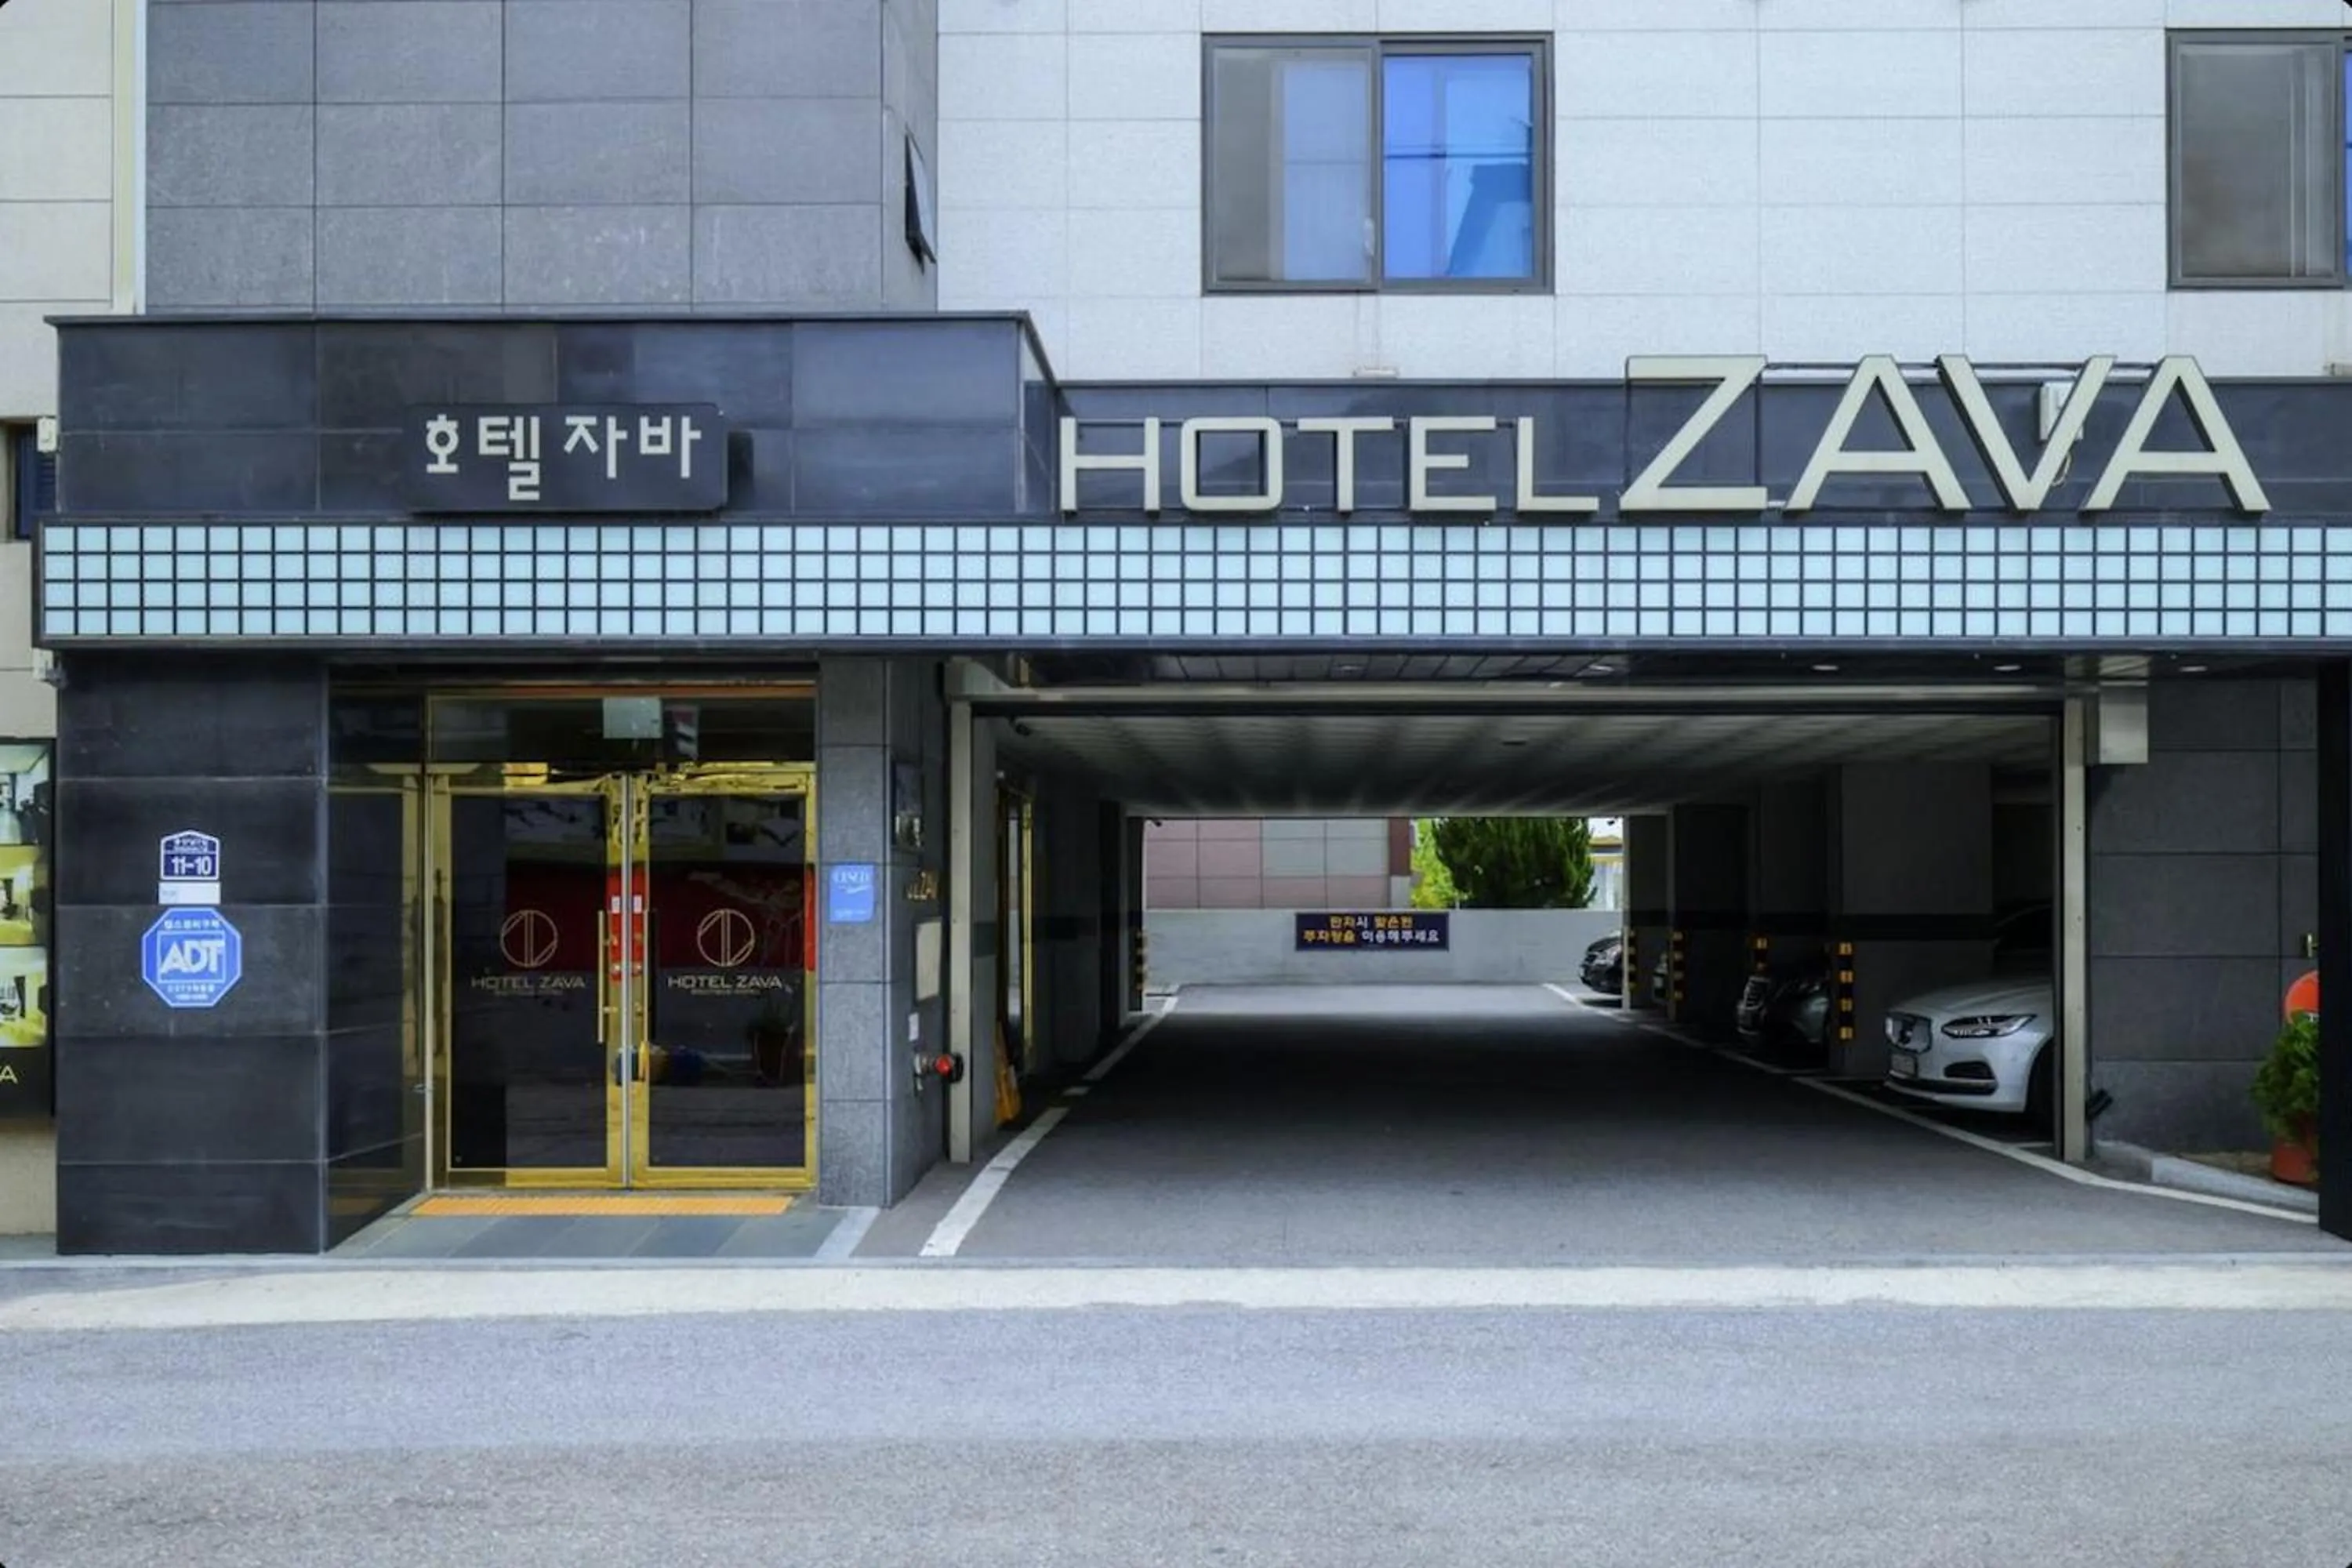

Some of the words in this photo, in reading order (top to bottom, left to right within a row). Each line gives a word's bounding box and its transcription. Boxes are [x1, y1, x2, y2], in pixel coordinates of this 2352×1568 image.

[1060, 416, 1599, 512] HOTEL
[1619, 354, 2272, 512] ZAVA
[171, 855, 212, 875] 11-10
[161, 940, 225, 973] ADT
[471, 975, 535, 989] HOTEL
[539, 975, 586, 989] ZAVA
[667, 975, 732, 989] HOTEL
[736, 975, 782, 989] ZAVA
